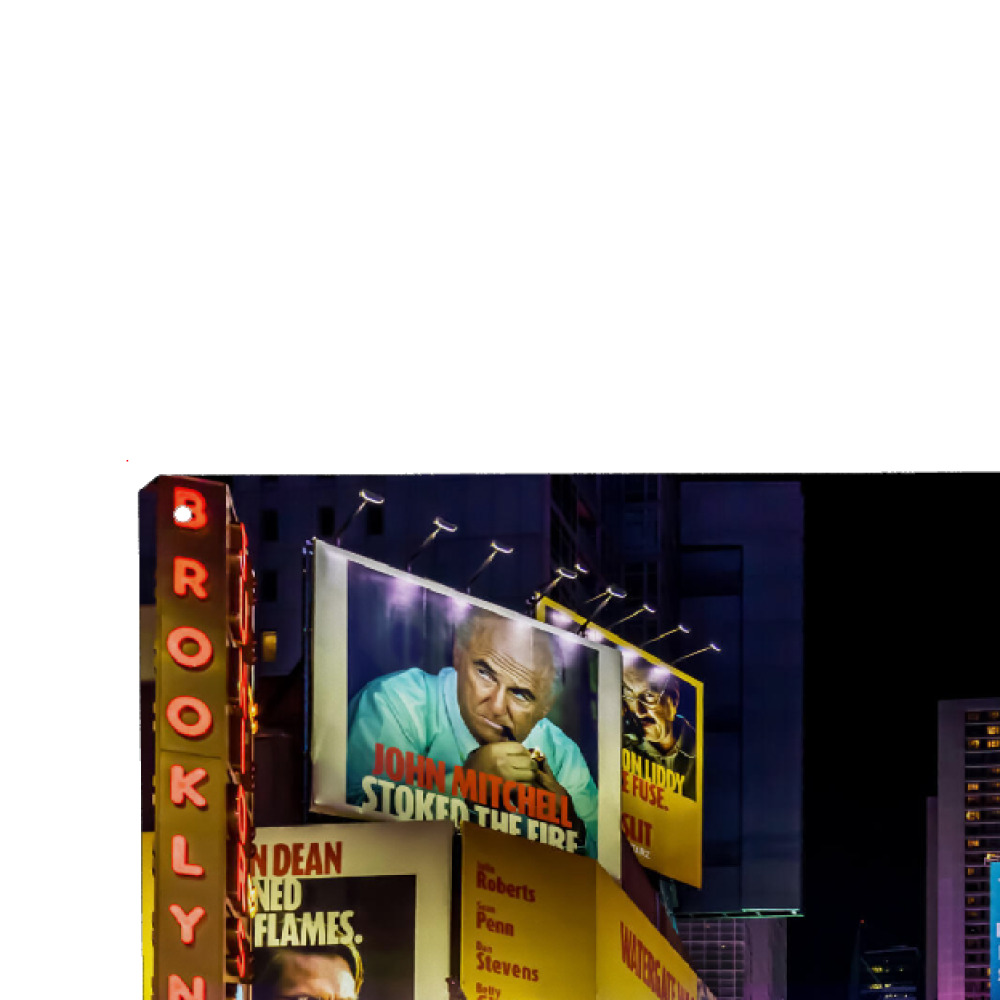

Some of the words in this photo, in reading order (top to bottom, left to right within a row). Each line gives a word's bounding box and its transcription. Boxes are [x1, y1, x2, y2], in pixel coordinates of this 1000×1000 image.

[373, 743, 446, 793] JOHN
[452, 765, 573, 829] MITCHELL
[632, 774, 669, 811] FUSE.
[474, 804, 523, 837] THE
[273, 841, 343, 877] DEAN
[476, 871, 536, 902] Roberts
[254, 910, 363, 948] FLAMES.
[476, 911, 514, 936] Penn
[476, 952, 539, 982] Stevens
